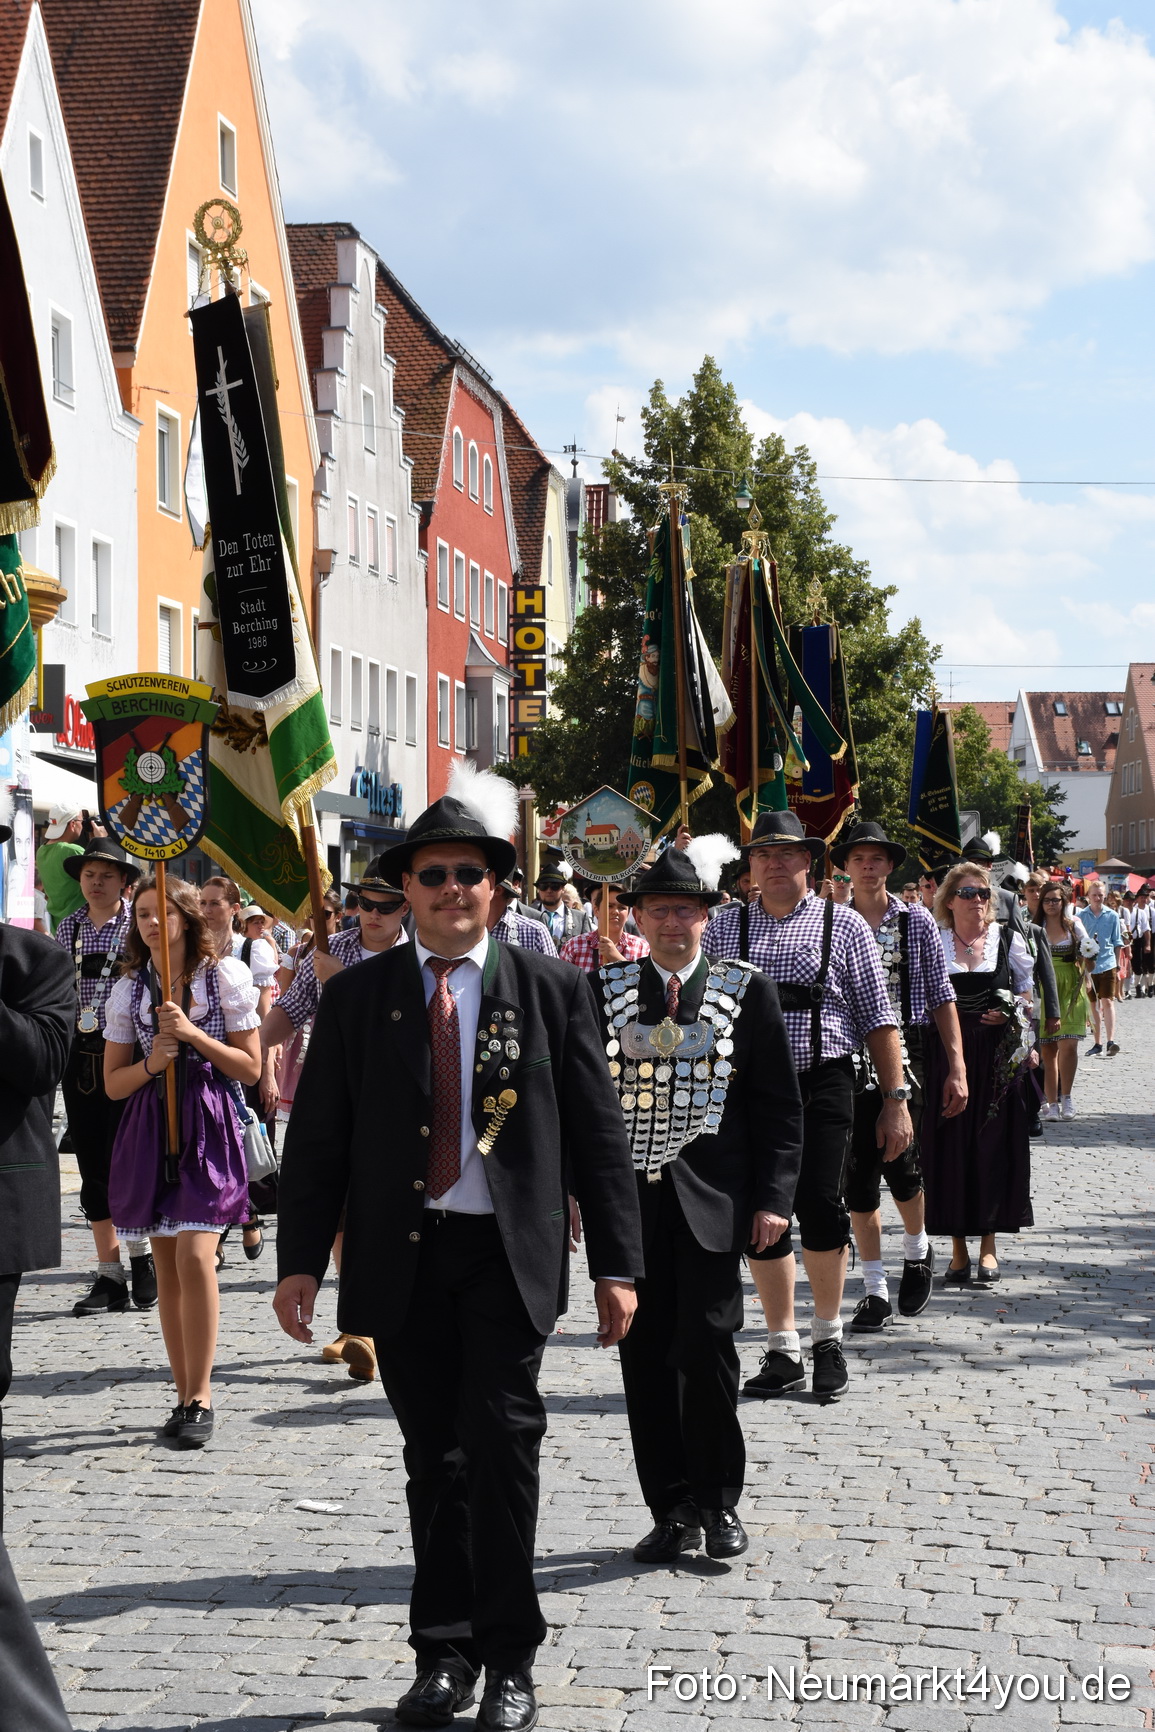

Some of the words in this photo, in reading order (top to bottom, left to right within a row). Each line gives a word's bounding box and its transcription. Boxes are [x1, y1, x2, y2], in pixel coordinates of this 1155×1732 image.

[218, 539, 239, 558] Den
[242, 532, 276, 551] Toten
[226, 562, 244, 579] zur
[240, 598, 267, 615] Stadt
[232, 618, 278, 635] Berching
[248, 635, 268, 650] 1988
[106, 676, 190, 695] SCHÜTZENVEREIN
[111, 697, 186, 718] BERCHING
[124, 840, 139, 853] vor
[144, 848, 166, 859] 1410
